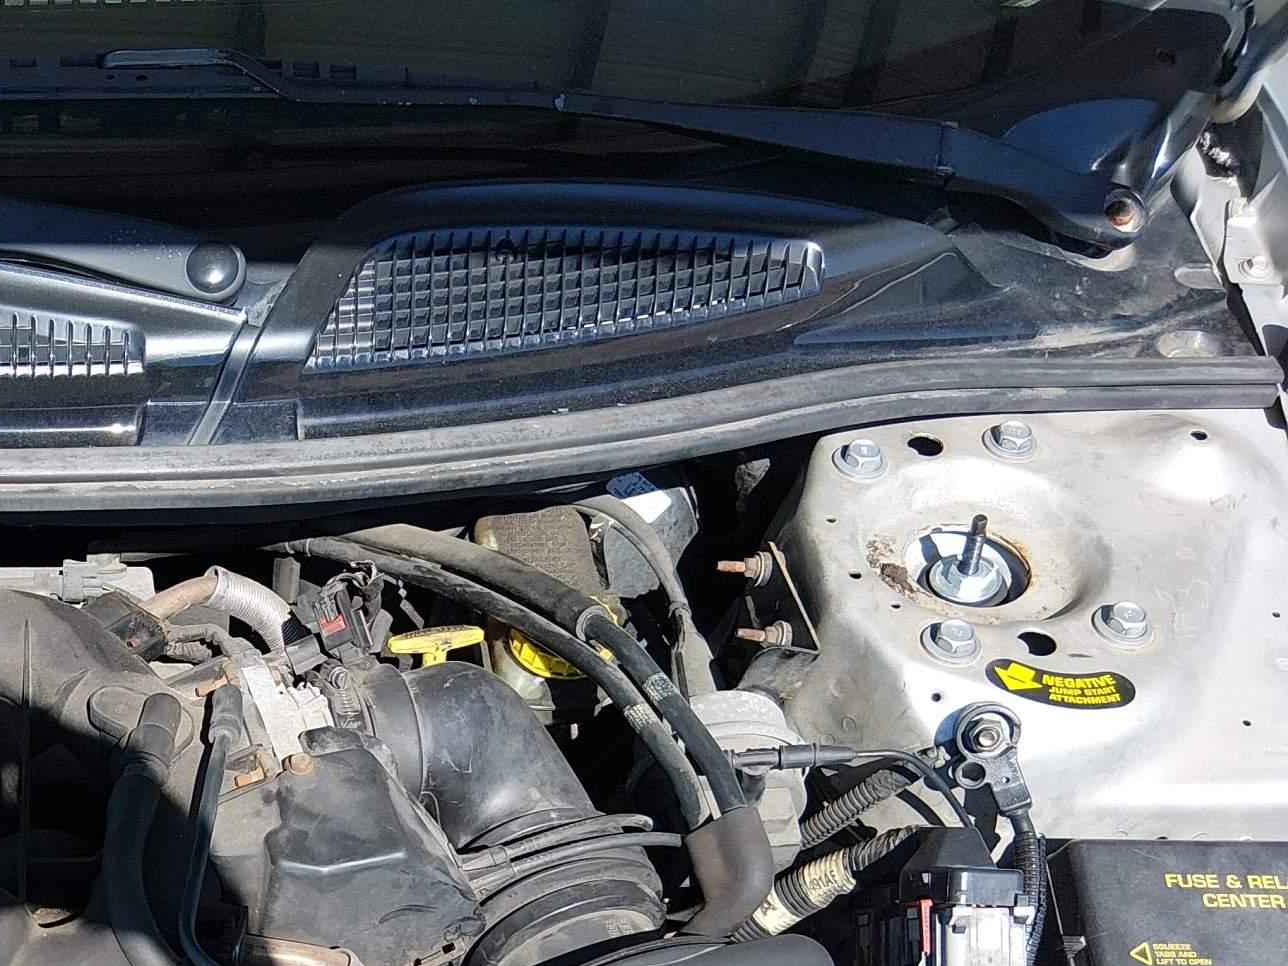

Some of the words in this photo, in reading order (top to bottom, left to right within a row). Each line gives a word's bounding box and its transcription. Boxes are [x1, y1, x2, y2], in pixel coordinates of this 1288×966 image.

[1042, 674, 1116, 688] NEGATIVE
[1049, 686, 1082, 695] JUMP
[1084, 686, 1116, 696] START
[1049, 694, 1121, 705] ATTACHMENT
[1165, 873, 1220, 889] FUSE
[1226, 874, 1242, 889] &
[1247, 875, 1288, 889] REL
[1202, 893, 1287, 909] CENTER
[1157, 958, 1174, 966] LIFT
[1176, 958, 1187, 966] TO
